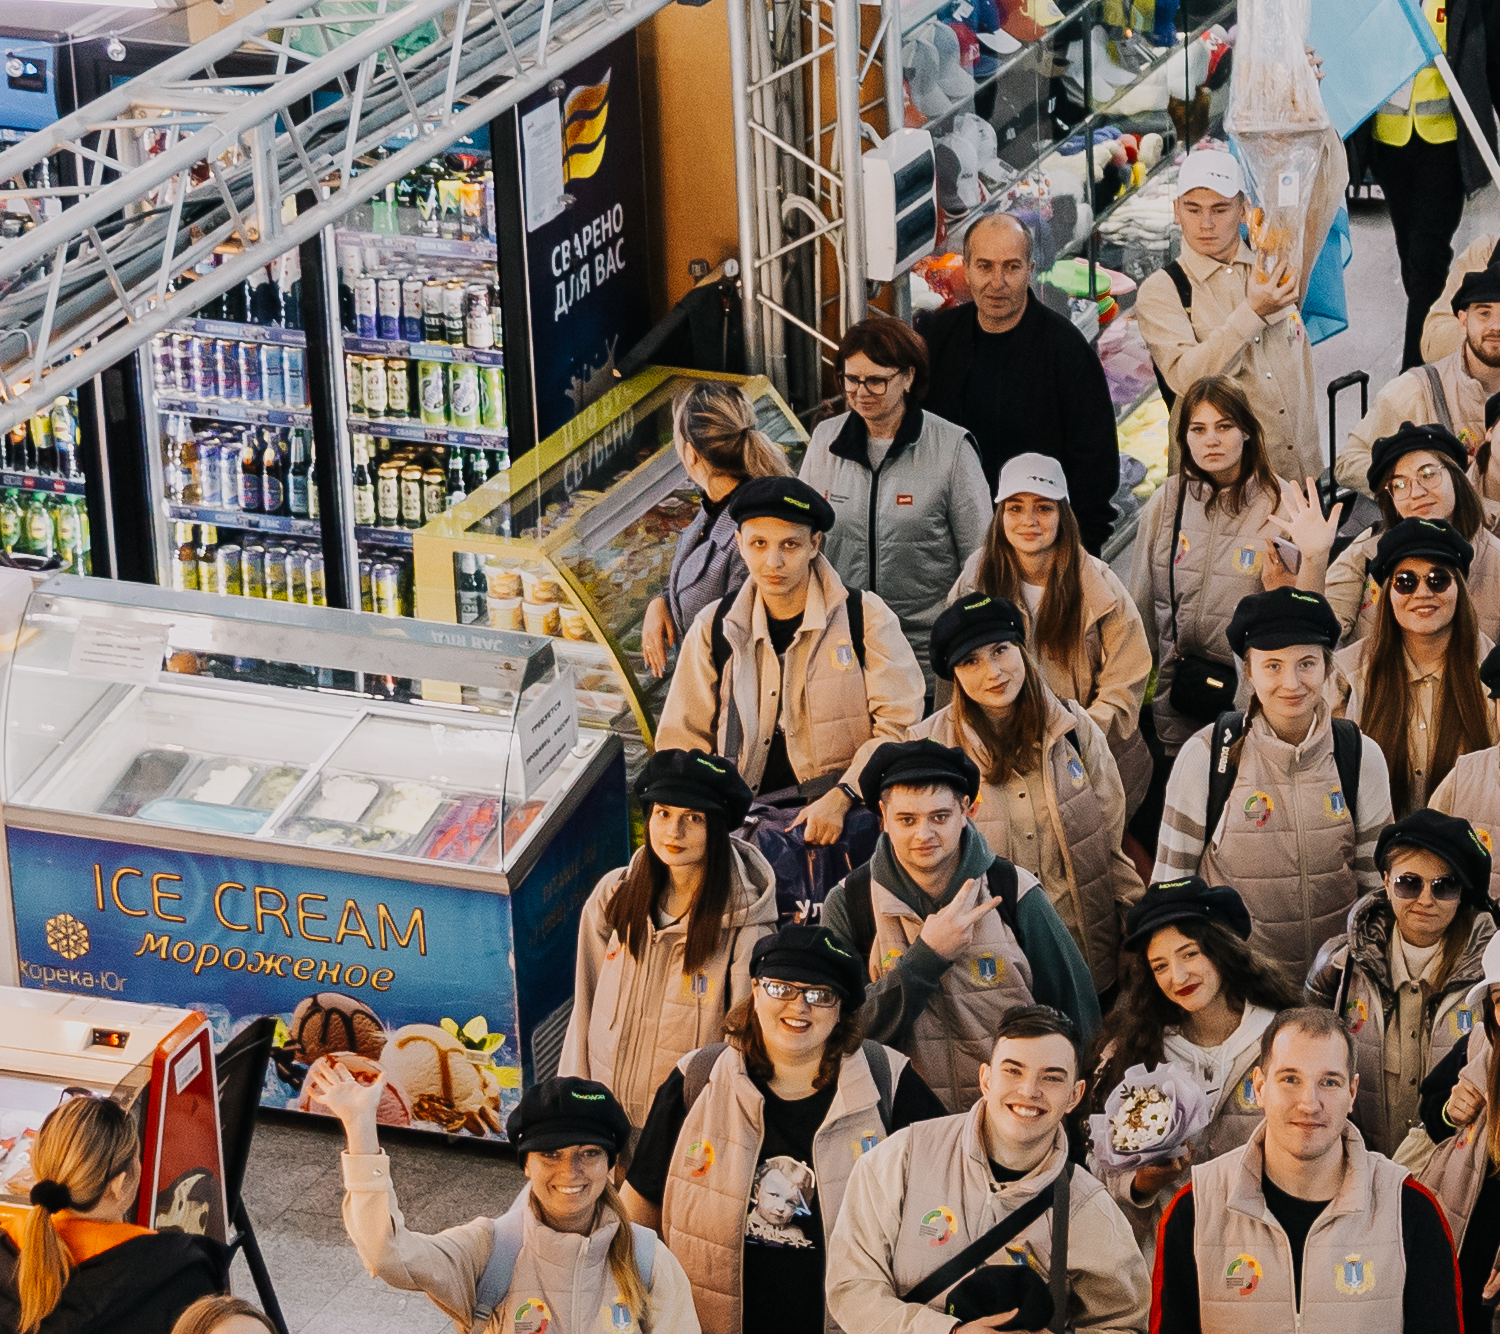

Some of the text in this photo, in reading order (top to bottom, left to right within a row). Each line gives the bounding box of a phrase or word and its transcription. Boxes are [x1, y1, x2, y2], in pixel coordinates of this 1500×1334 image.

[551, 203, 624, 277] СВАРЕНО
[553, 238, 626, 322] ДЛЯ ВАС
[530, 699, 563, 735] ТРЕБУЕТСЯ
[93, 864, 428, 956] ICE CREAM
[134, 930, 396, 993] мороженое
